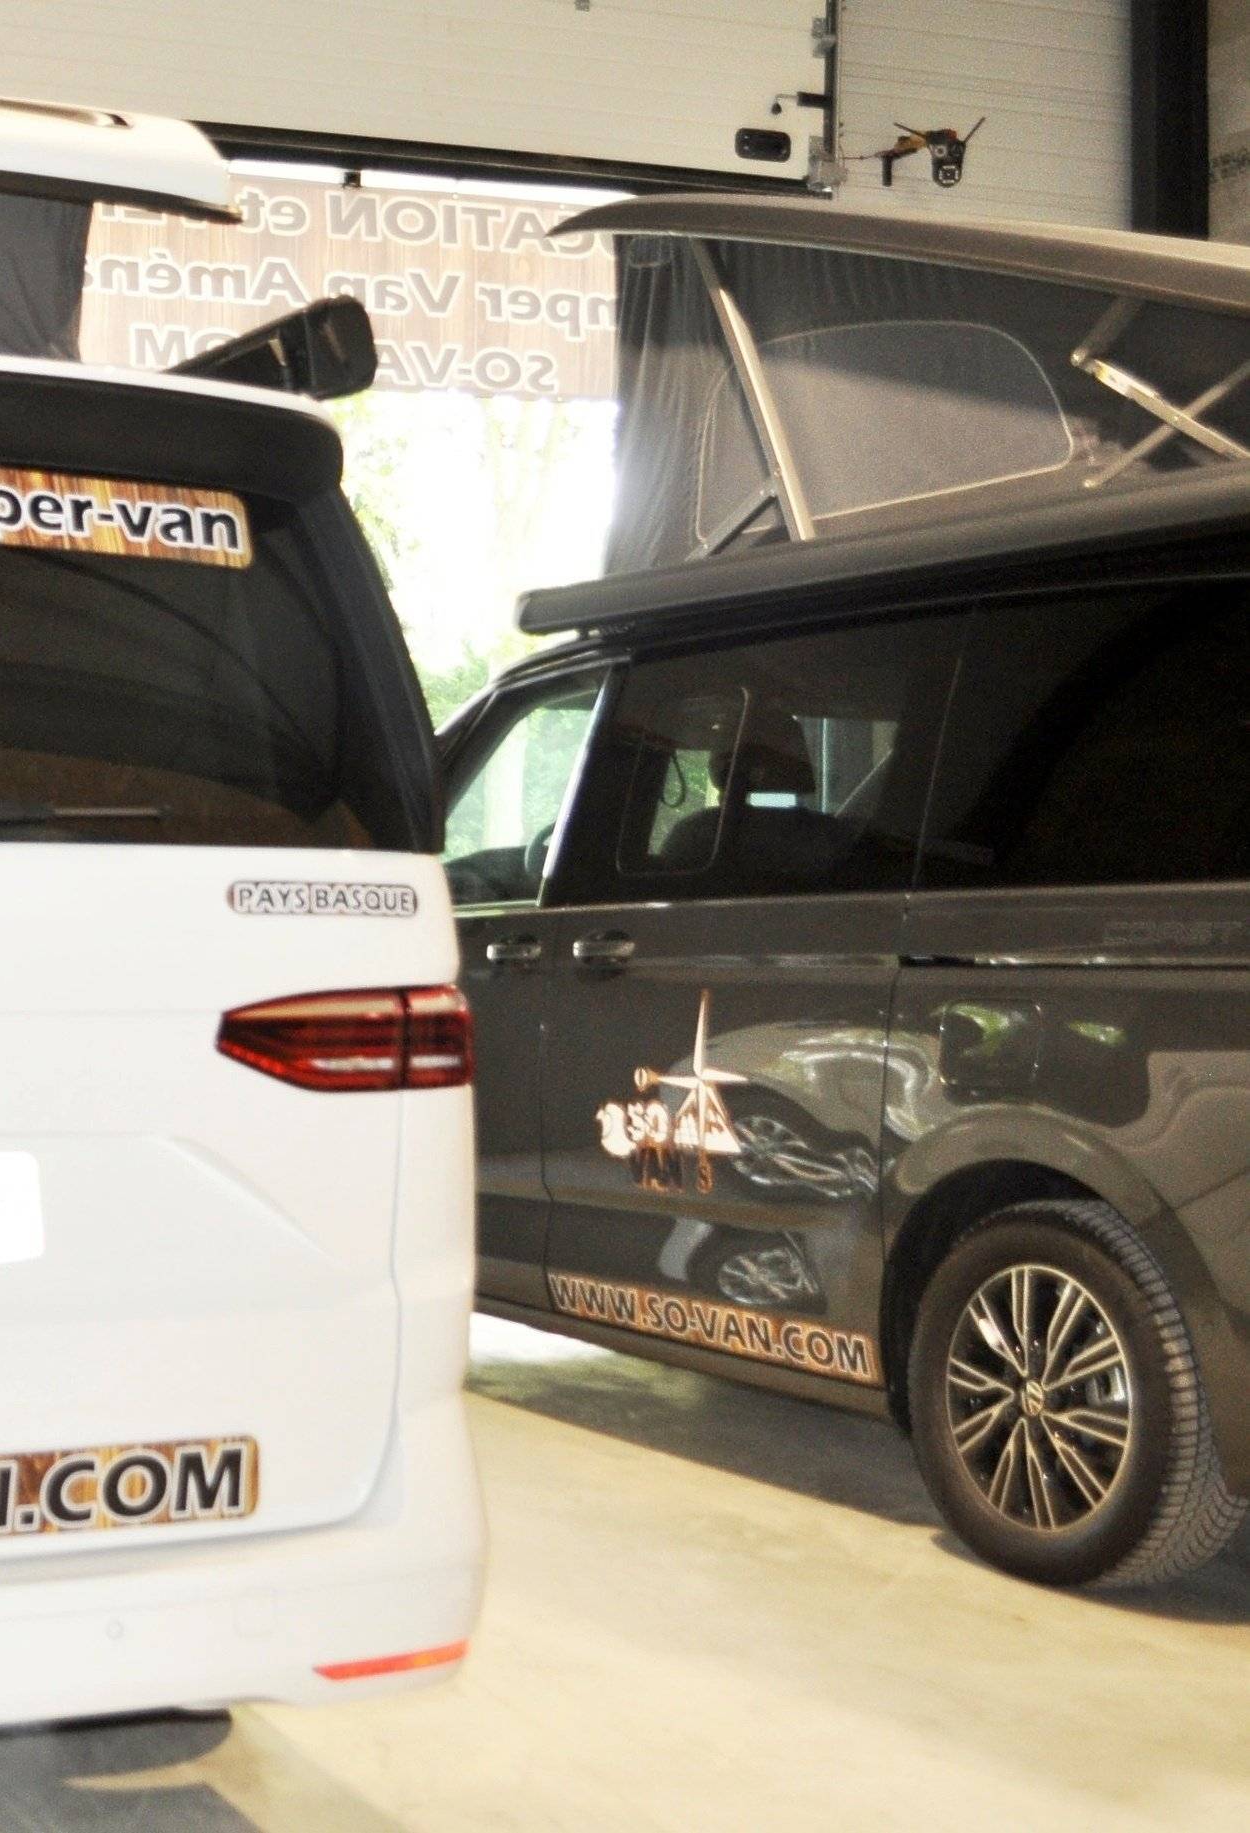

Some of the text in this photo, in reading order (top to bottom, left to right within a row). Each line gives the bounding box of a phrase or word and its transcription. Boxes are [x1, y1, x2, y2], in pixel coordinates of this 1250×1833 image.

[238, 888, 410, 912] PAYS BASQUE
[549, 1277, 869, 1376] WWW.SO-VAN.COM
